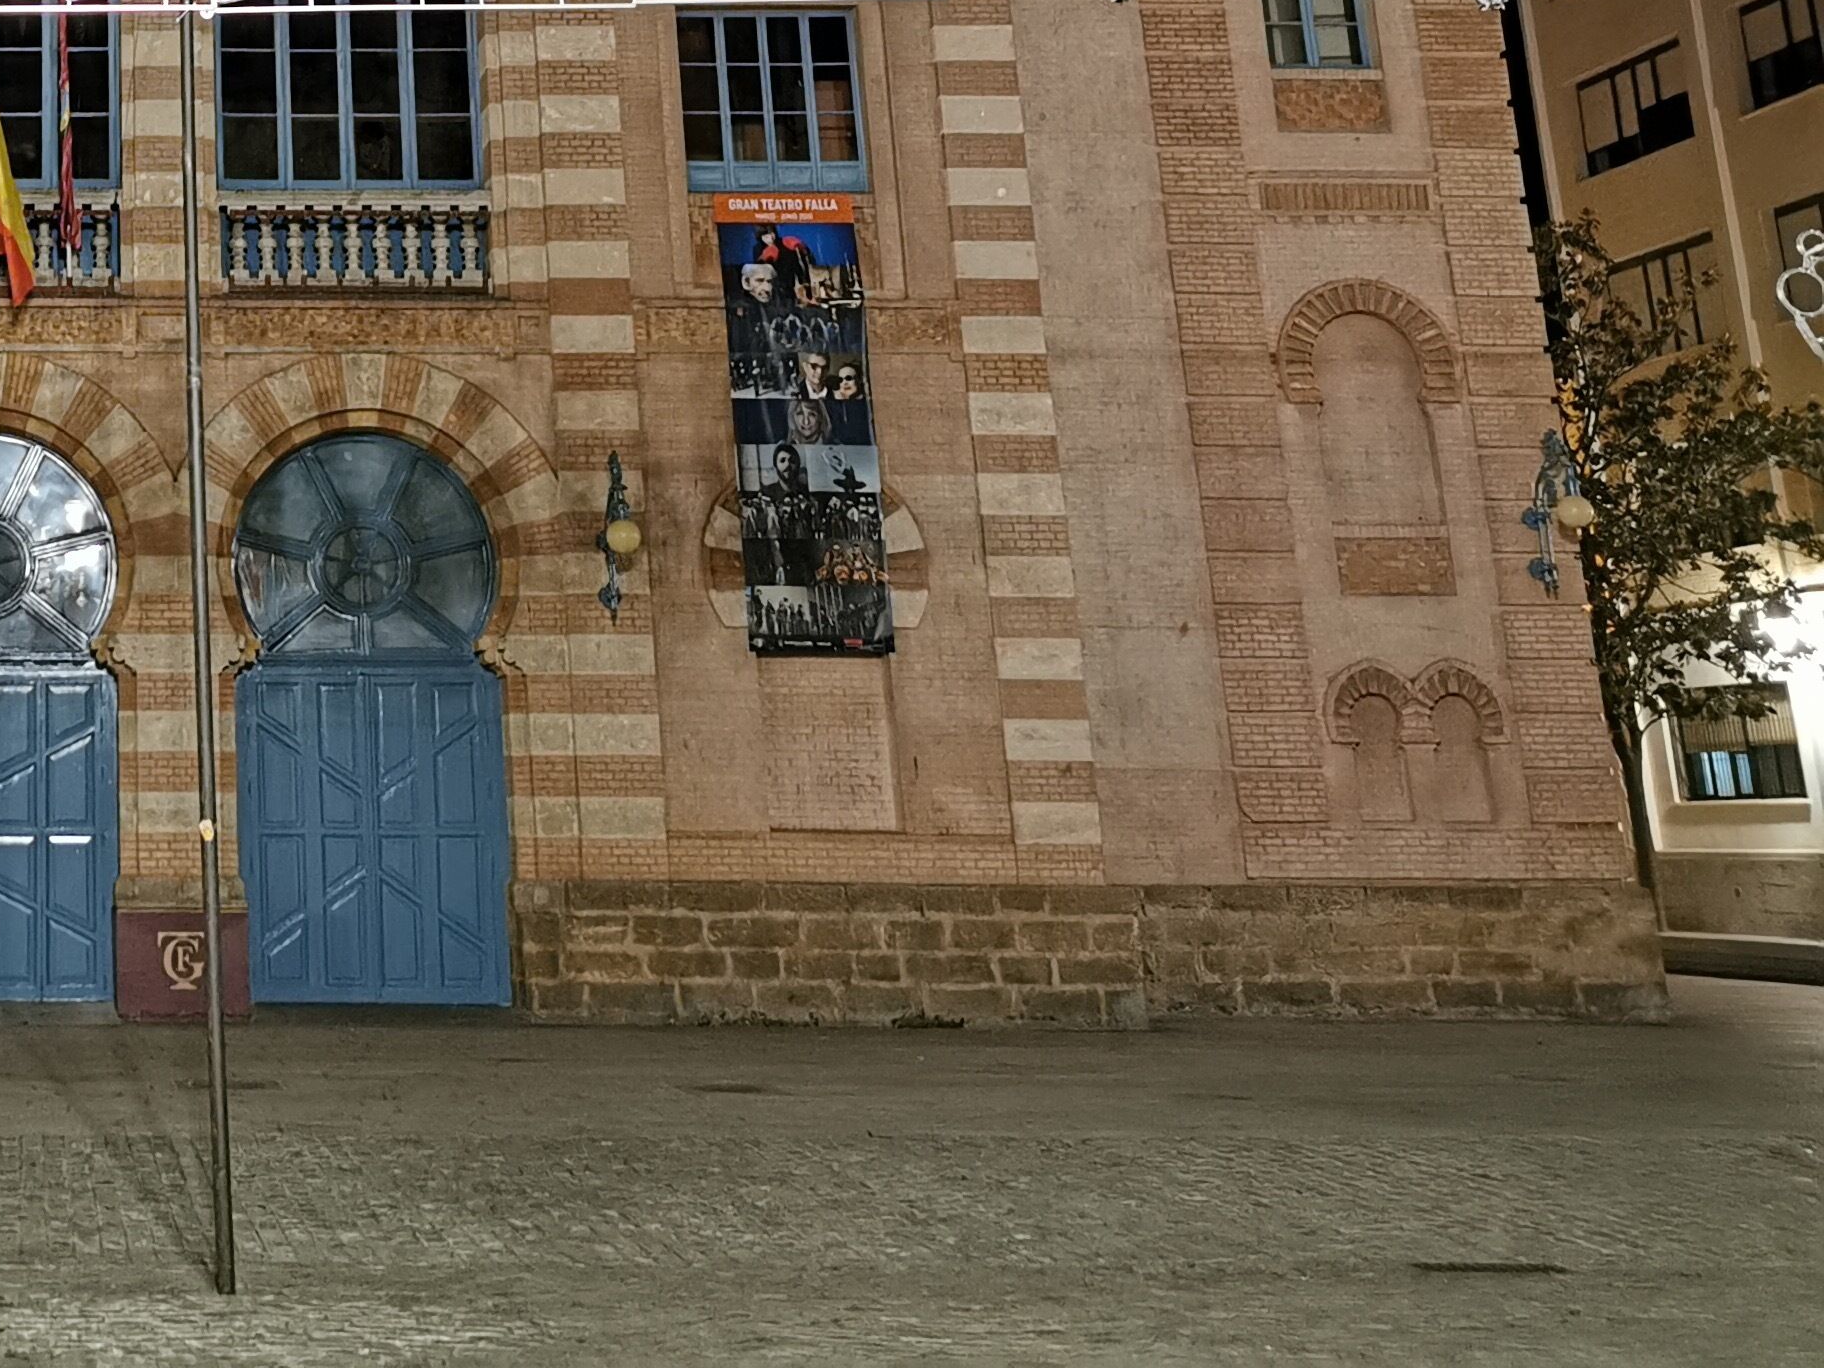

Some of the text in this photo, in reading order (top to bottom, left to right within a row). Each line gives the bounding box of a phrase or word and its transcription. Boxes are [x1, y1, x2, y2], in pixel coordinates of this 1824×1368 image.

[728, 198, 838, 211] GRAN TEATRO FALLA
